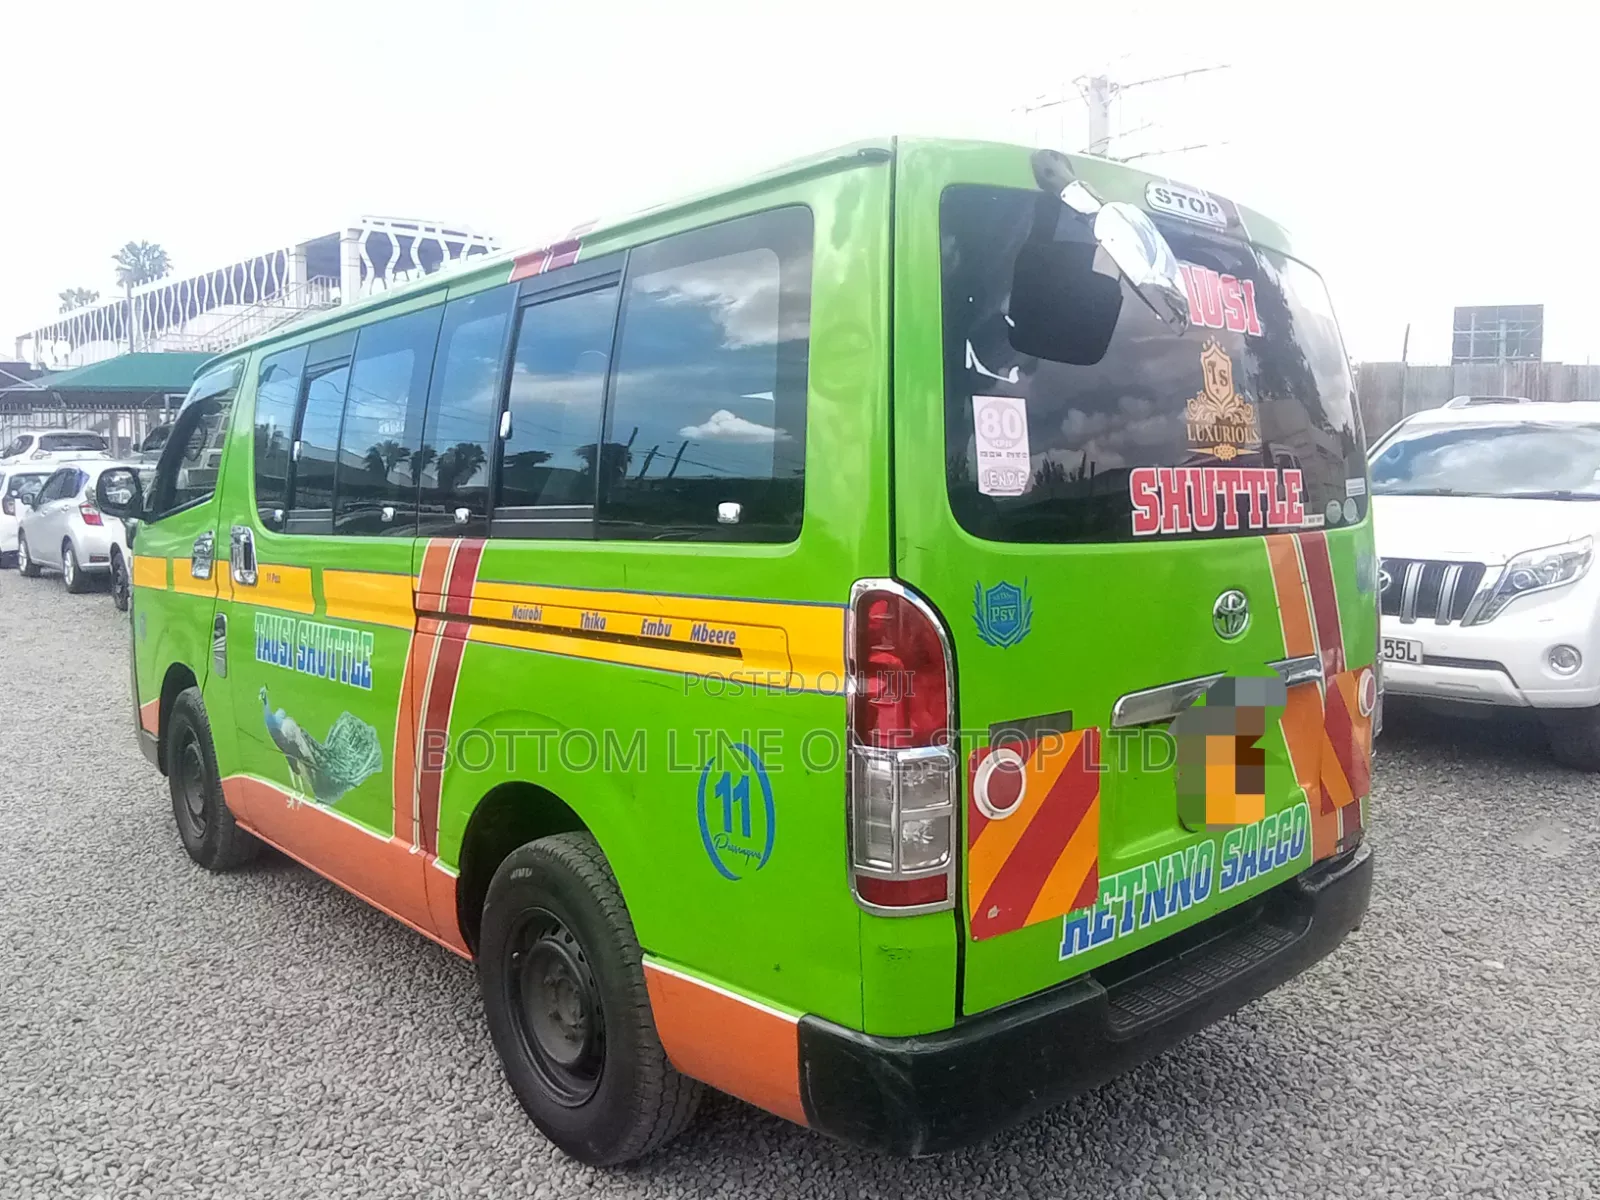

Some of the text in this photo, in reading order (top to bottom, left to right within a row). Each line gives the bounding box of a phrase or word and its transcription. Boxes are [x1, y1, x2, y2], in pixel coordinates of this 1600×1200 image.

[1154, 187, 1219, 216] STOP
[979, 407, 1023, 440] 80
[1186, 423, 1261, 443] LUXURIOUS
[1129, 467, 1304, 536] SHUTTLE
[255, 611, 374, 691] TAUSI SHUTTLE
[511, 604, 736, 645] Nairobi Thika Embu Mbeere
[714, 771, 752, 838] 11
[1219, 802, 1307, 894] SACCO
